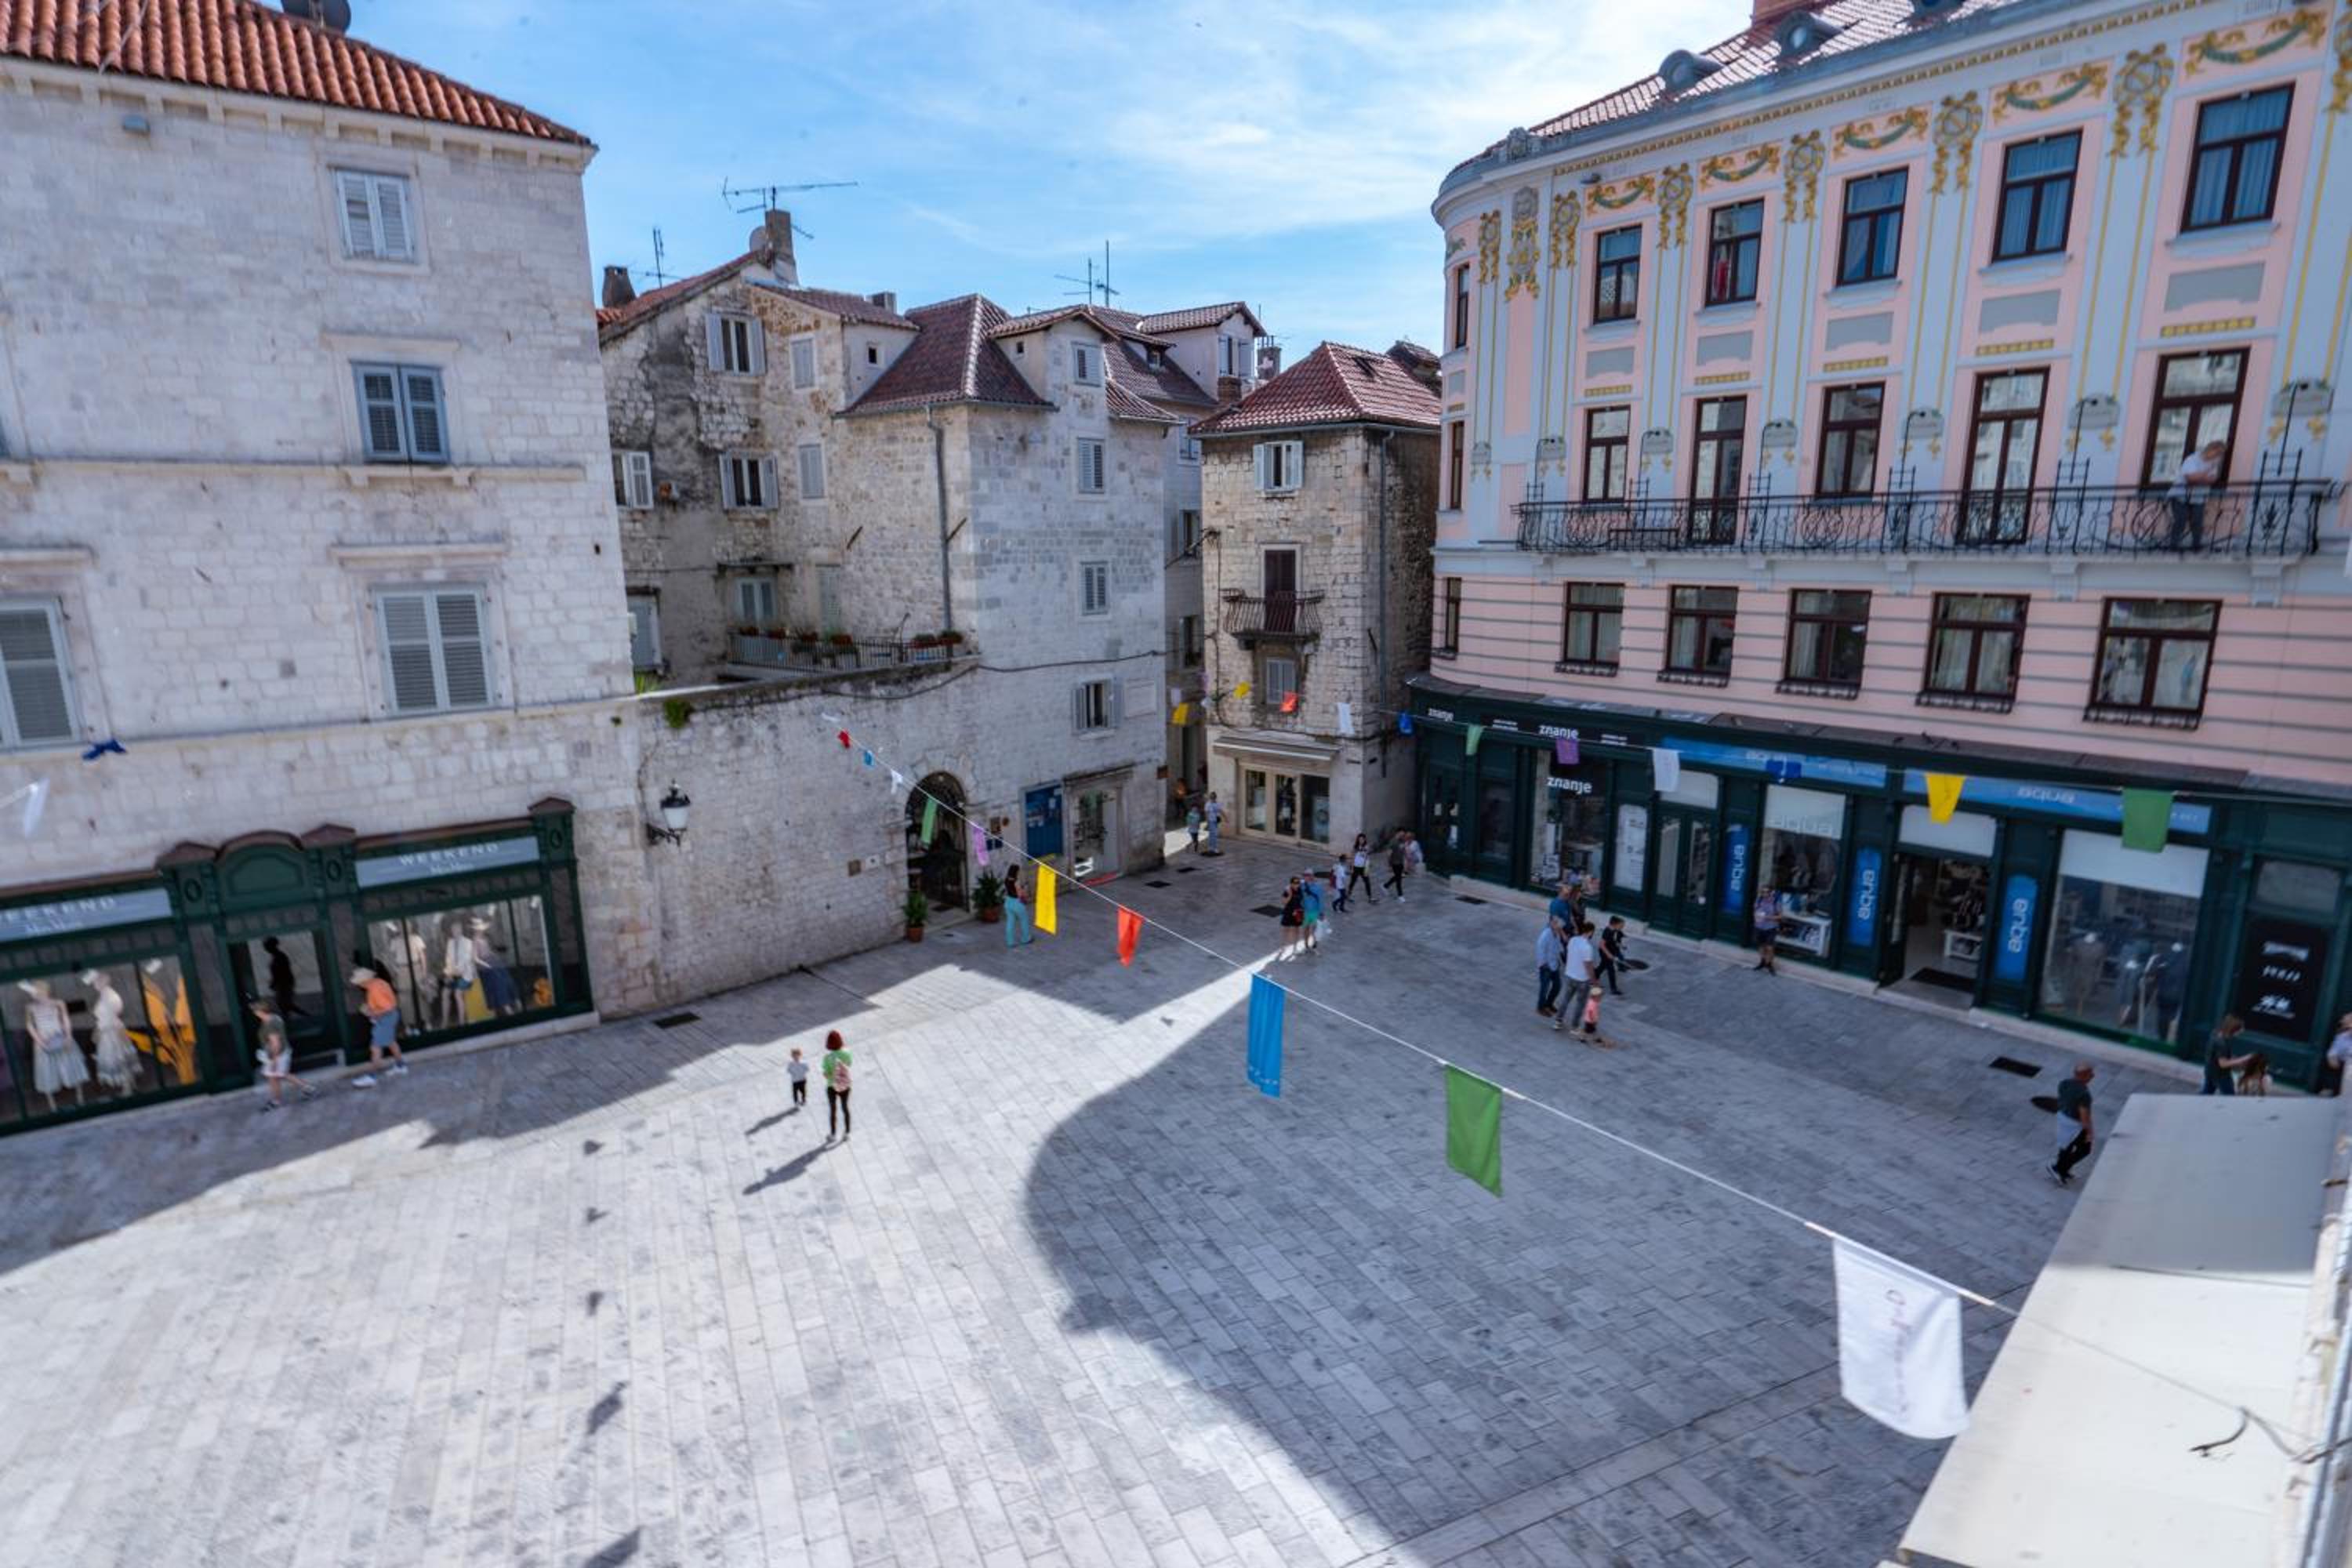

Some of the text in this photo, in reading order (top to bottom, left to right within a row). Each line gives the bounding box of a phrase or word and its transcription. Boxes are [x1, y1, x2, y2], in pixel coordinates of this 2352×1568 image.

[1539, 724, 1579, 740] znanje
[1547, 776, 1592, 795] znanje
[2017, 786, 2076, 804] aqua
[398, 842, 499, 866] WEEKEND
[1730, 844, 1744, 891] aqua
[1857, 869, 1876, 920] aqua
[2007, 898, 2029, 954] aqua
